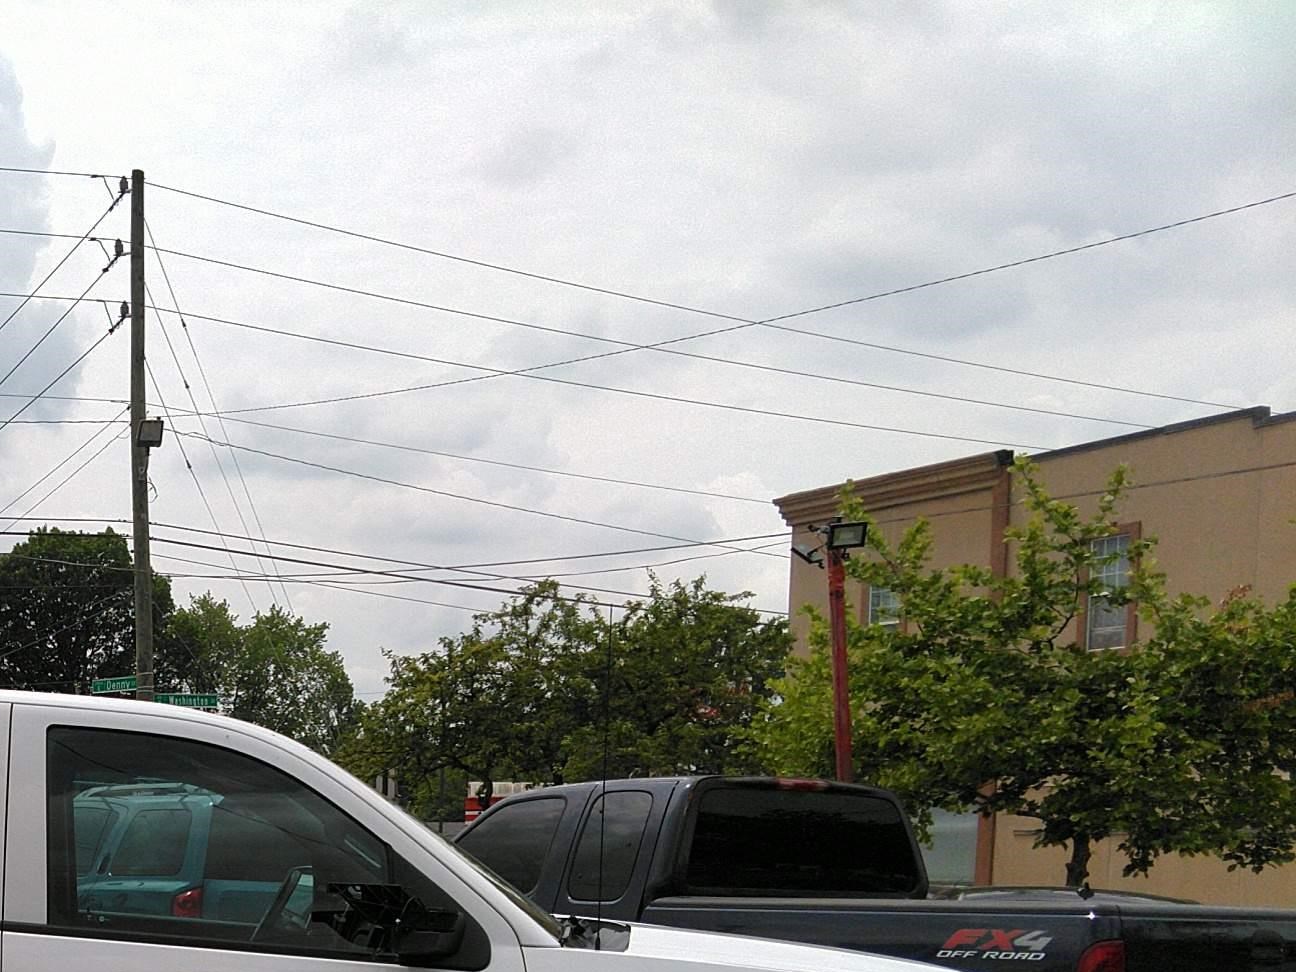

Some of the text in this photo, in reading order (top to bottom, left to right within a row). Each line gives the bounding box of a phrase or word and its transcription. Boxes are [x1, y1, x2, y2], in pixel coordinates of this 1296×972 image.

[106, 680, 131, 690] Denny
[169, 695, 208, 706] Washington
[942, 928, 1054, 951] FX4
[935, 950, 1047, 961] OFF ROAD
